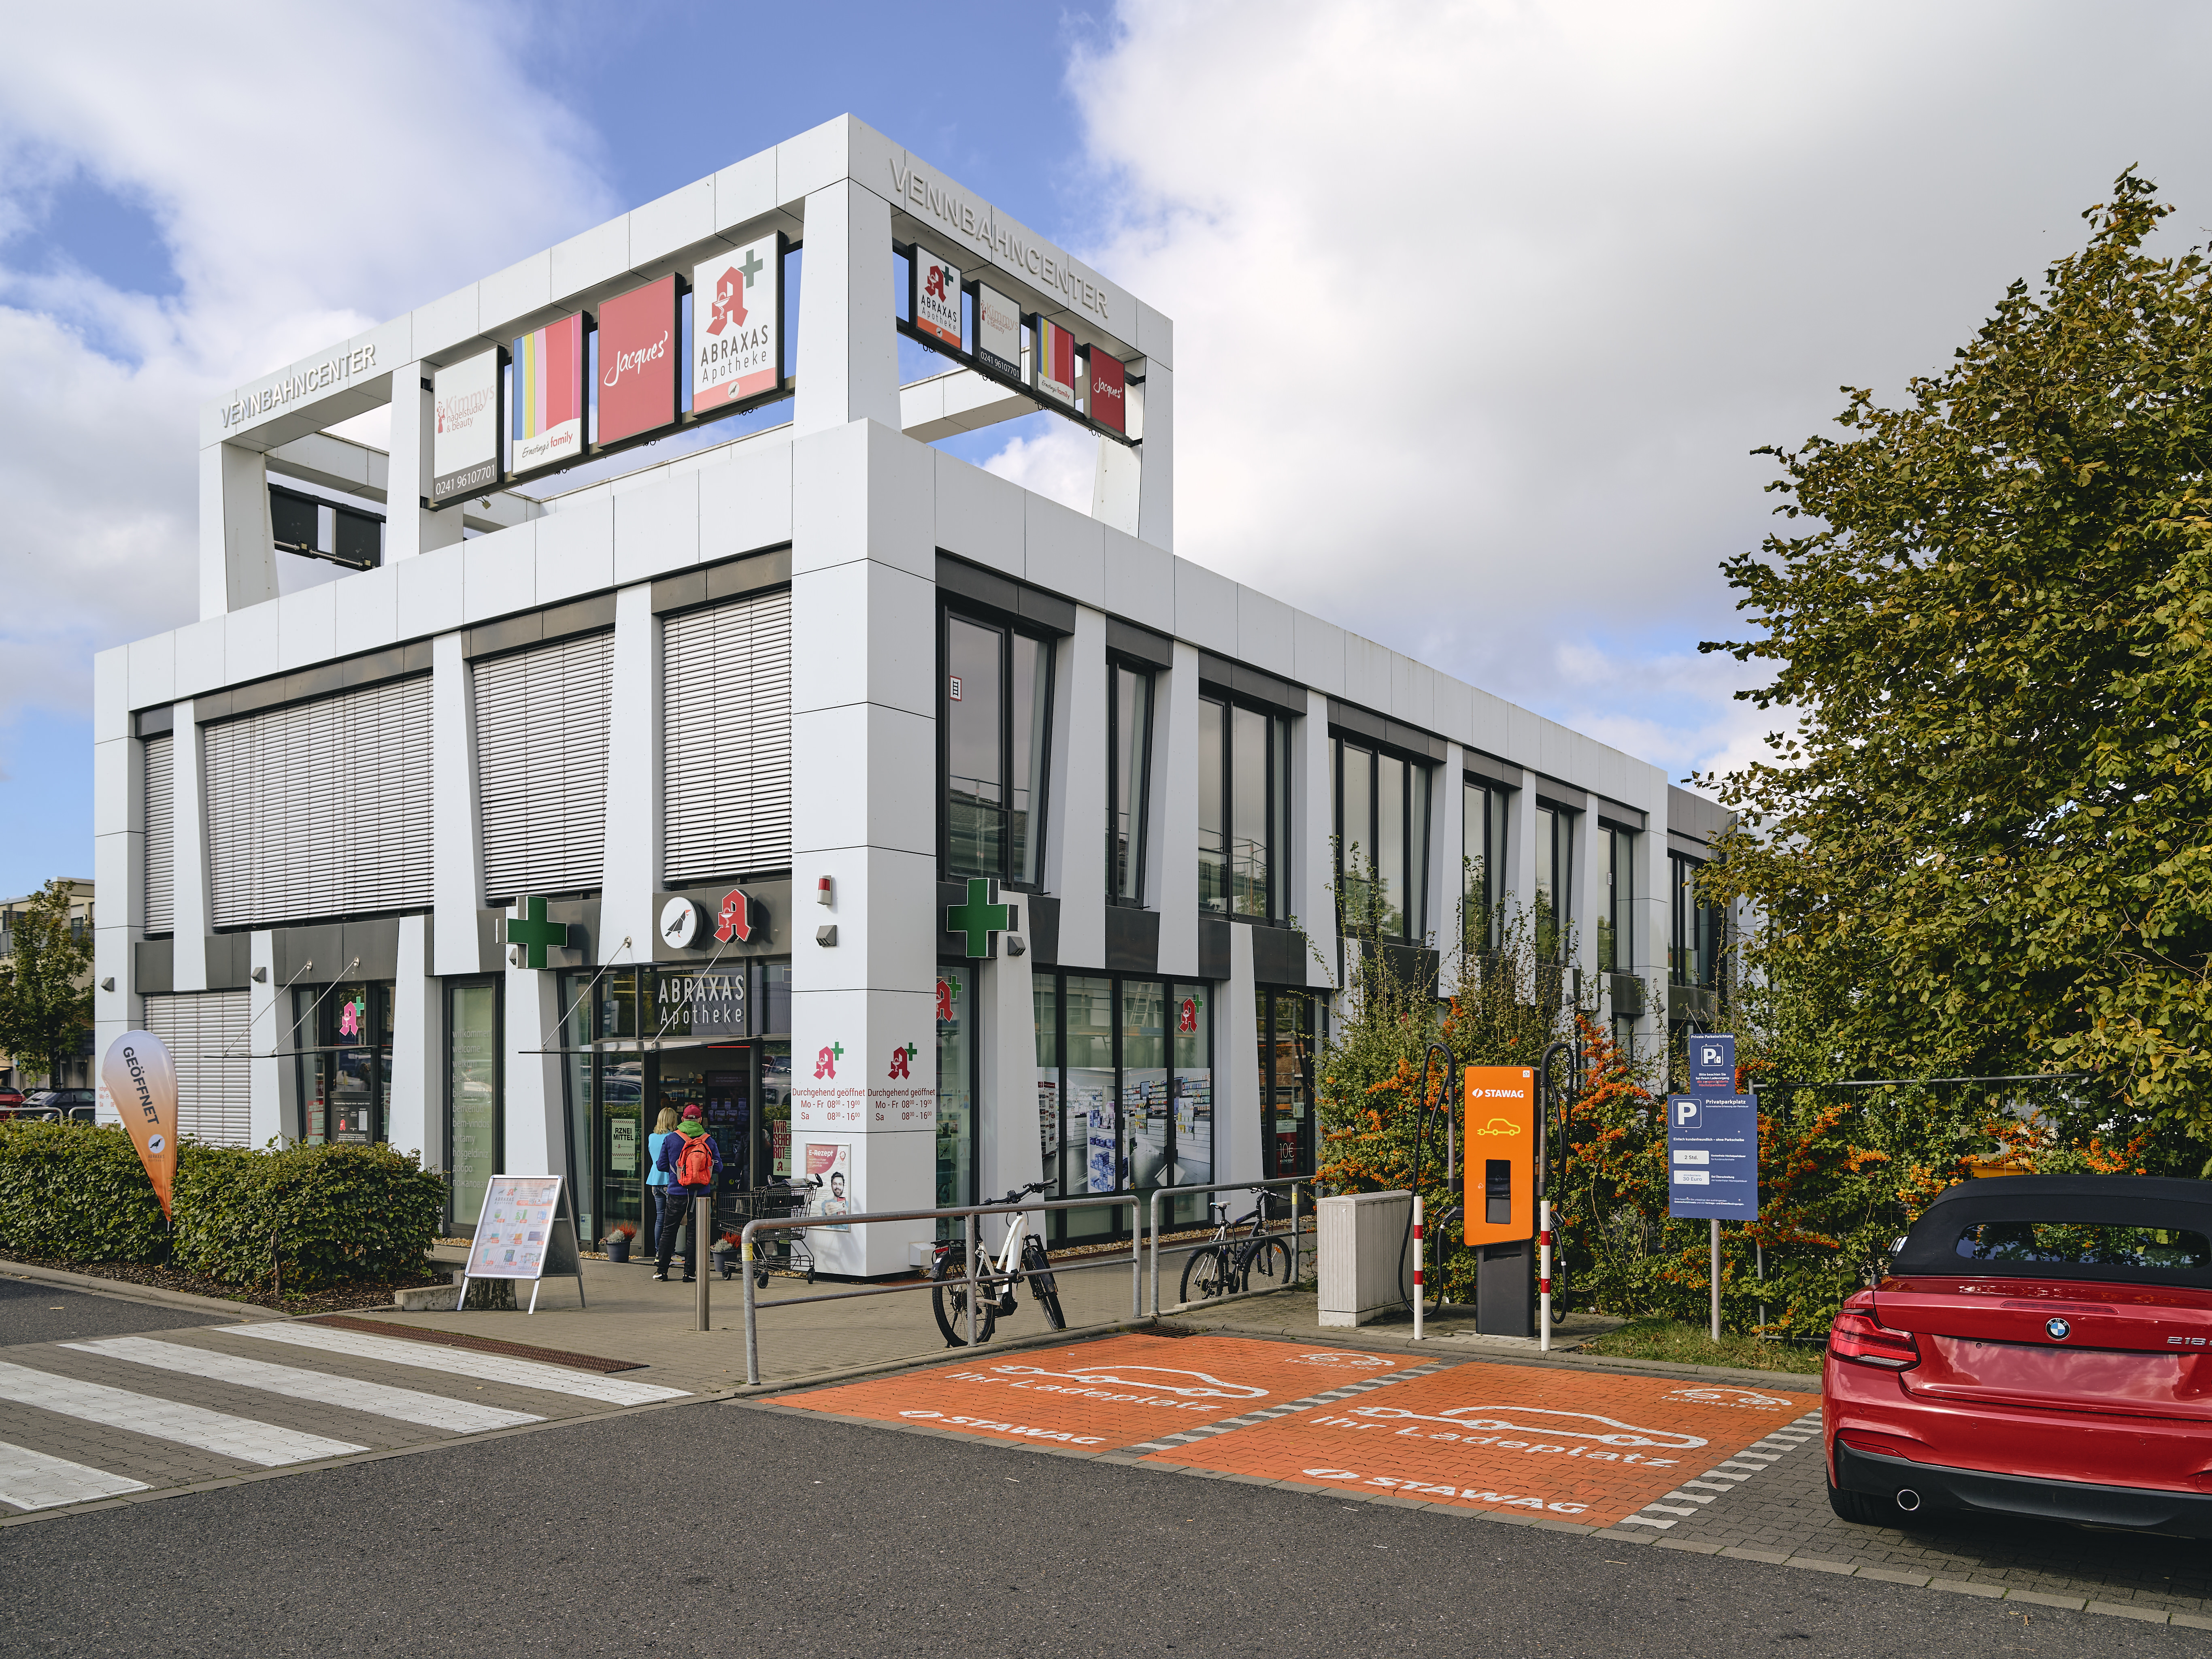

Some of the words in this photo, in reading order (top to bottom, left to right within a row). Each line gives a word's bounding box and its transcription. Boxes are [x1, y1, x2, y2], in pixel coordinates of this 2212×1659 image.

[890, 158, 1108, 319] VENNBAHNCENTER
[921, 294, 957, 322] ABRAXAS
[987, 302, 1019, 330] Kimmys
[922, 307, 956, 332] Apotheke
[987, 314, 1011, 331] nagelstudio
[990, 321, 1005, 334] beauty
[701, 324, 768, 367] ABRAXAS
[702, 349, 767, 384] Apotheke
[981, 351, 993, 364] 0241
[994, 358, 1019, 378] 96107701
[220, 343, 376, 428] VENNBAHNCENTER
[1041, 380, 1057, 393] Ernsting's
[1057, 387, 1070, 400] family
[446, 385, 495, 417] Kimmys
[447, 403, 483, 423] nagelstudio
[452, 417, 473, 431] beauty
[521, 441, 549, 458] Ernsting's
[550, 430, 573, 448] family
[436, 478, 454, 495] 0241
[457, 464, 495, 488] 96107701
[658, 974, 744, 1003] ABRAXAS
[660, 1003, 742, 1030] Apotheke
[452, 1028, 491, 1038] willkommen
[452, 1044, 481, 1053] welcome
[452, 1058, 477, 1068] welkom
[123, 1047, 160, 1124] GEÖFFNET
[453, 1073, 485, 1083] bienvenue
[792, 1088, 835, 1098] Durchgehend
[837, 1088, 865, 1098] geöffnet
[868, 1088, 909, 1098] Durchgehend
[910, 1088, 935, 1098] geöffnet
[1485, 1089, 1524, 1098] STAWAG
[453, 1103, 484, 1112] benvenuti
[876, 1101, 886, 1109] Mo
[1678, 1102, 1697, 1125] P
[452, 1117, 489, 1128] bem-vindos
[876, 1113, 884, 1121] Sa
[773, 1120, 787, 1133] WIR
[452, 1133, 475, 1145] witamy
[453, 1147, 488, 1160] hoşgeldiniz
[773, 1146, 786, 1159] ROT
[809, 1150, 833, 1158] E-Rezept
[1279, 1142, 1294, 1159] 10€
[452, 1163, 473, 1174] добро
[453, 1179, 488, 1188] пожаловат
[2048, 1318, 2068, 1327] BMW
[1009, 1380, 1222, 1411] Ladeplatz
[940, 1416, 1107, 1445] STAWAG
[1395, 1426, 1680, 1467] Ladeplatz
[1363, 1477, 1590, 1514] STAWAG
